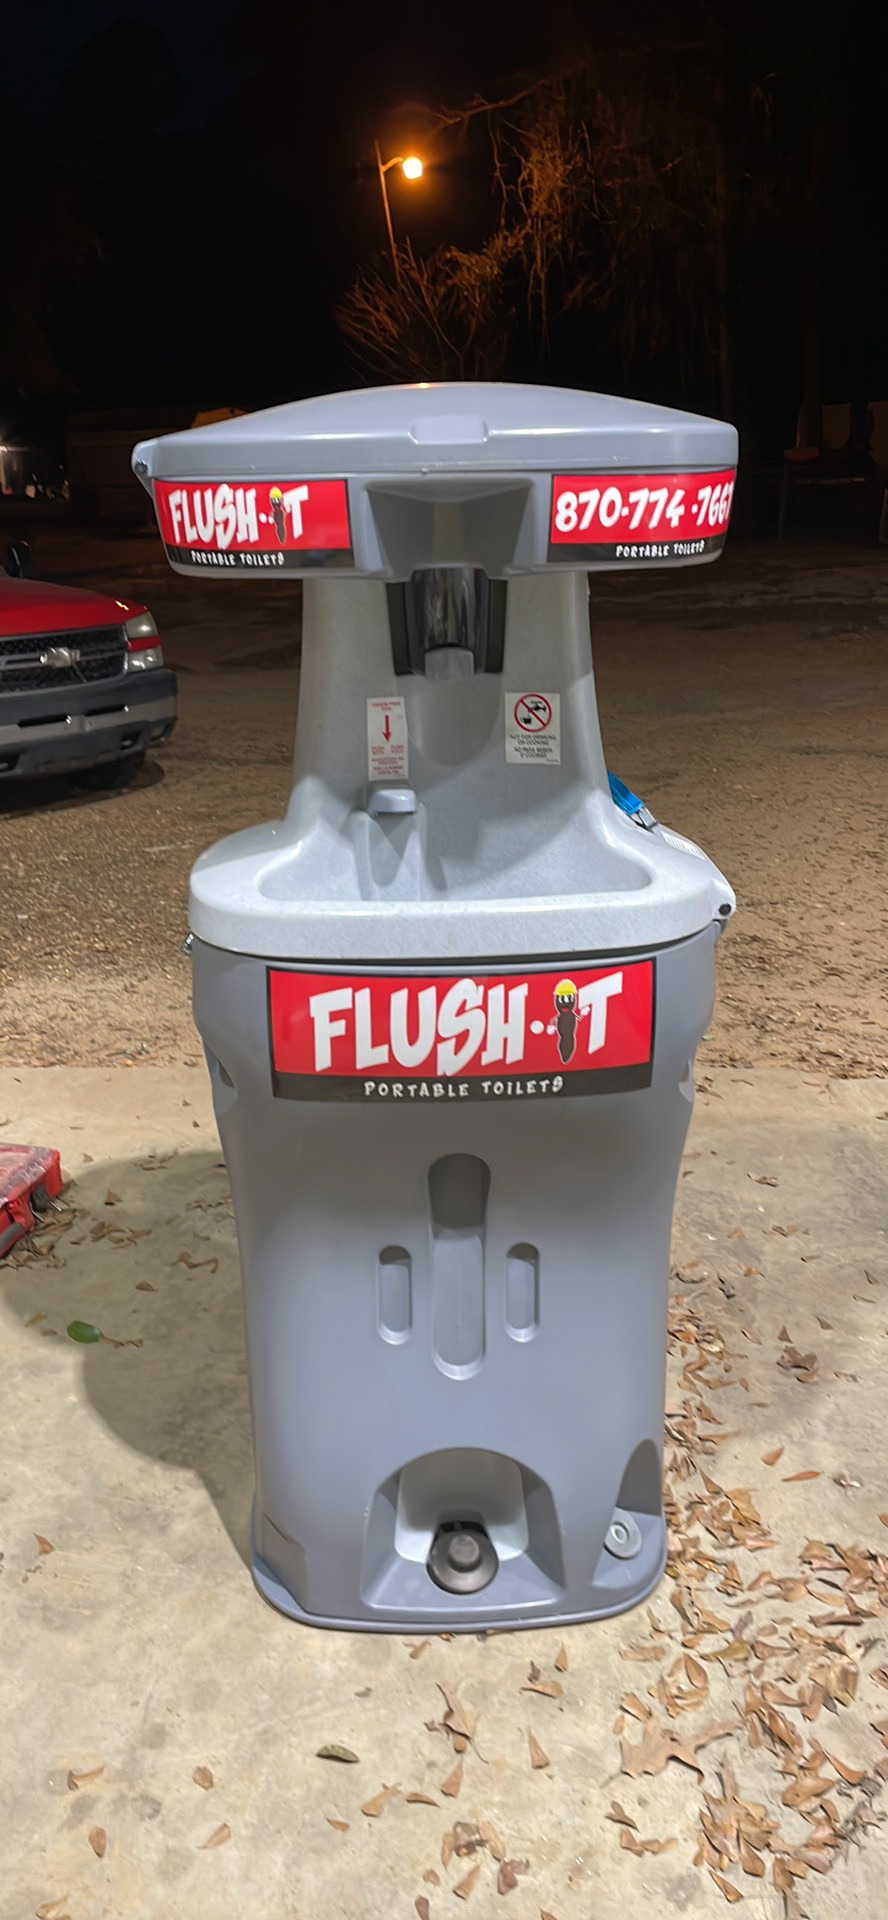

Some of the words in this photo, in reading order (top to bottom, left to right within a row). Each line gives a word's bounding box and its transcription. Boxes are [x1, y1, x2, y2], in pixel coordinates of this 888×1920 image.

[191, 550, 236, 566] PORTABLE
[239, 551, 285, 566] TOILETS
[615, 544, 669, 558] PORTABLE
[673, 539, 705, 556] TOILETS
[364, 1080, 469, 1098] PORTABLE
[481, 1075, 564, 1096] TOILETS
